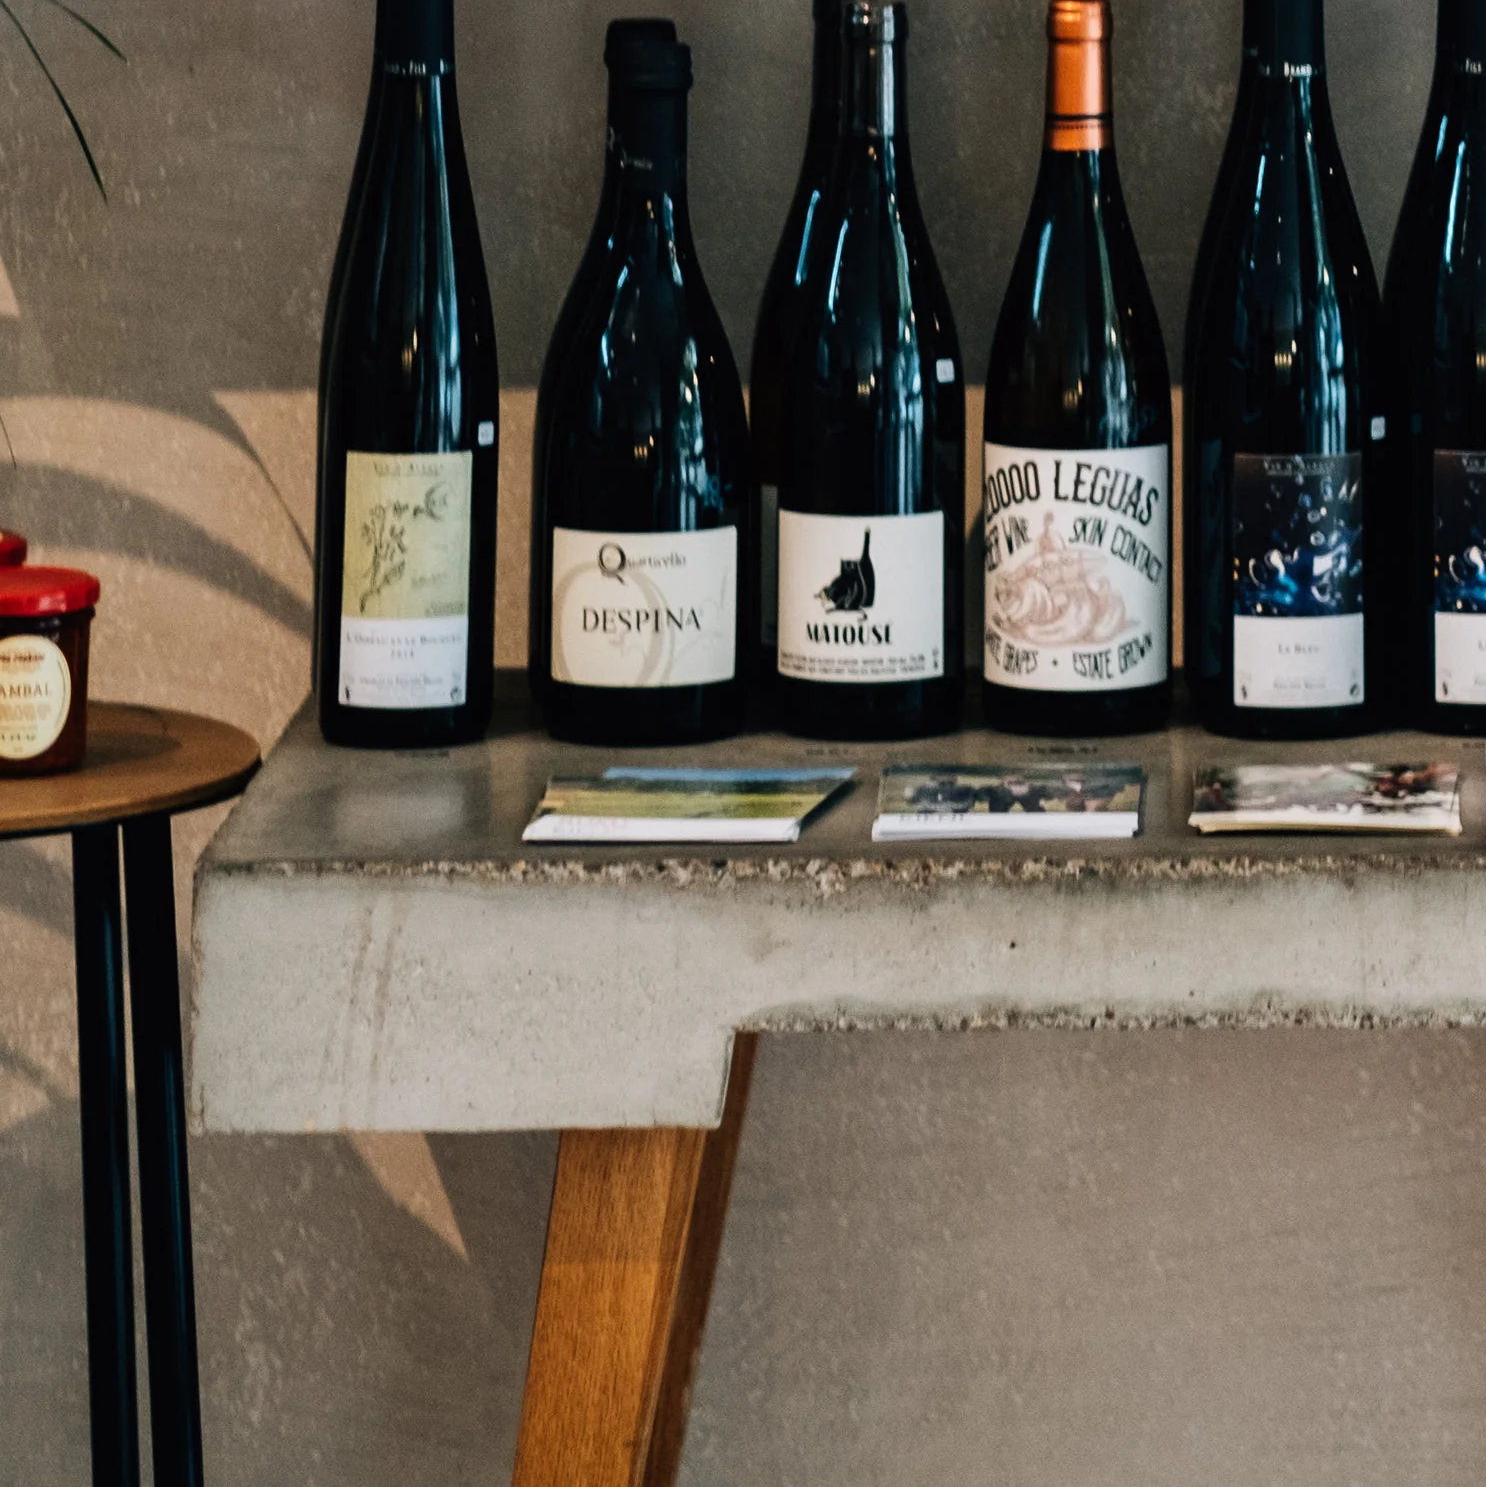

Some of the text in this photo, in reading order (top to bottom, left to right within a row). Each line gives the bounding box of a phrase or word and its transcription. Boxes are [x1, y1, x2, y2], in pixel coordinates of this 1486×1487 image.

[1053, 460, 1160, 527] LEGUAS
[1001, 515, 1032, 556] WINE
[1068, 515, 1108, 549] SKIN
[582, 605, 703, 635] DESPINA
[1003, 641, 1039, 676] GRAPES
[1072, 630, 1153, 680] ESTATE GROWN
